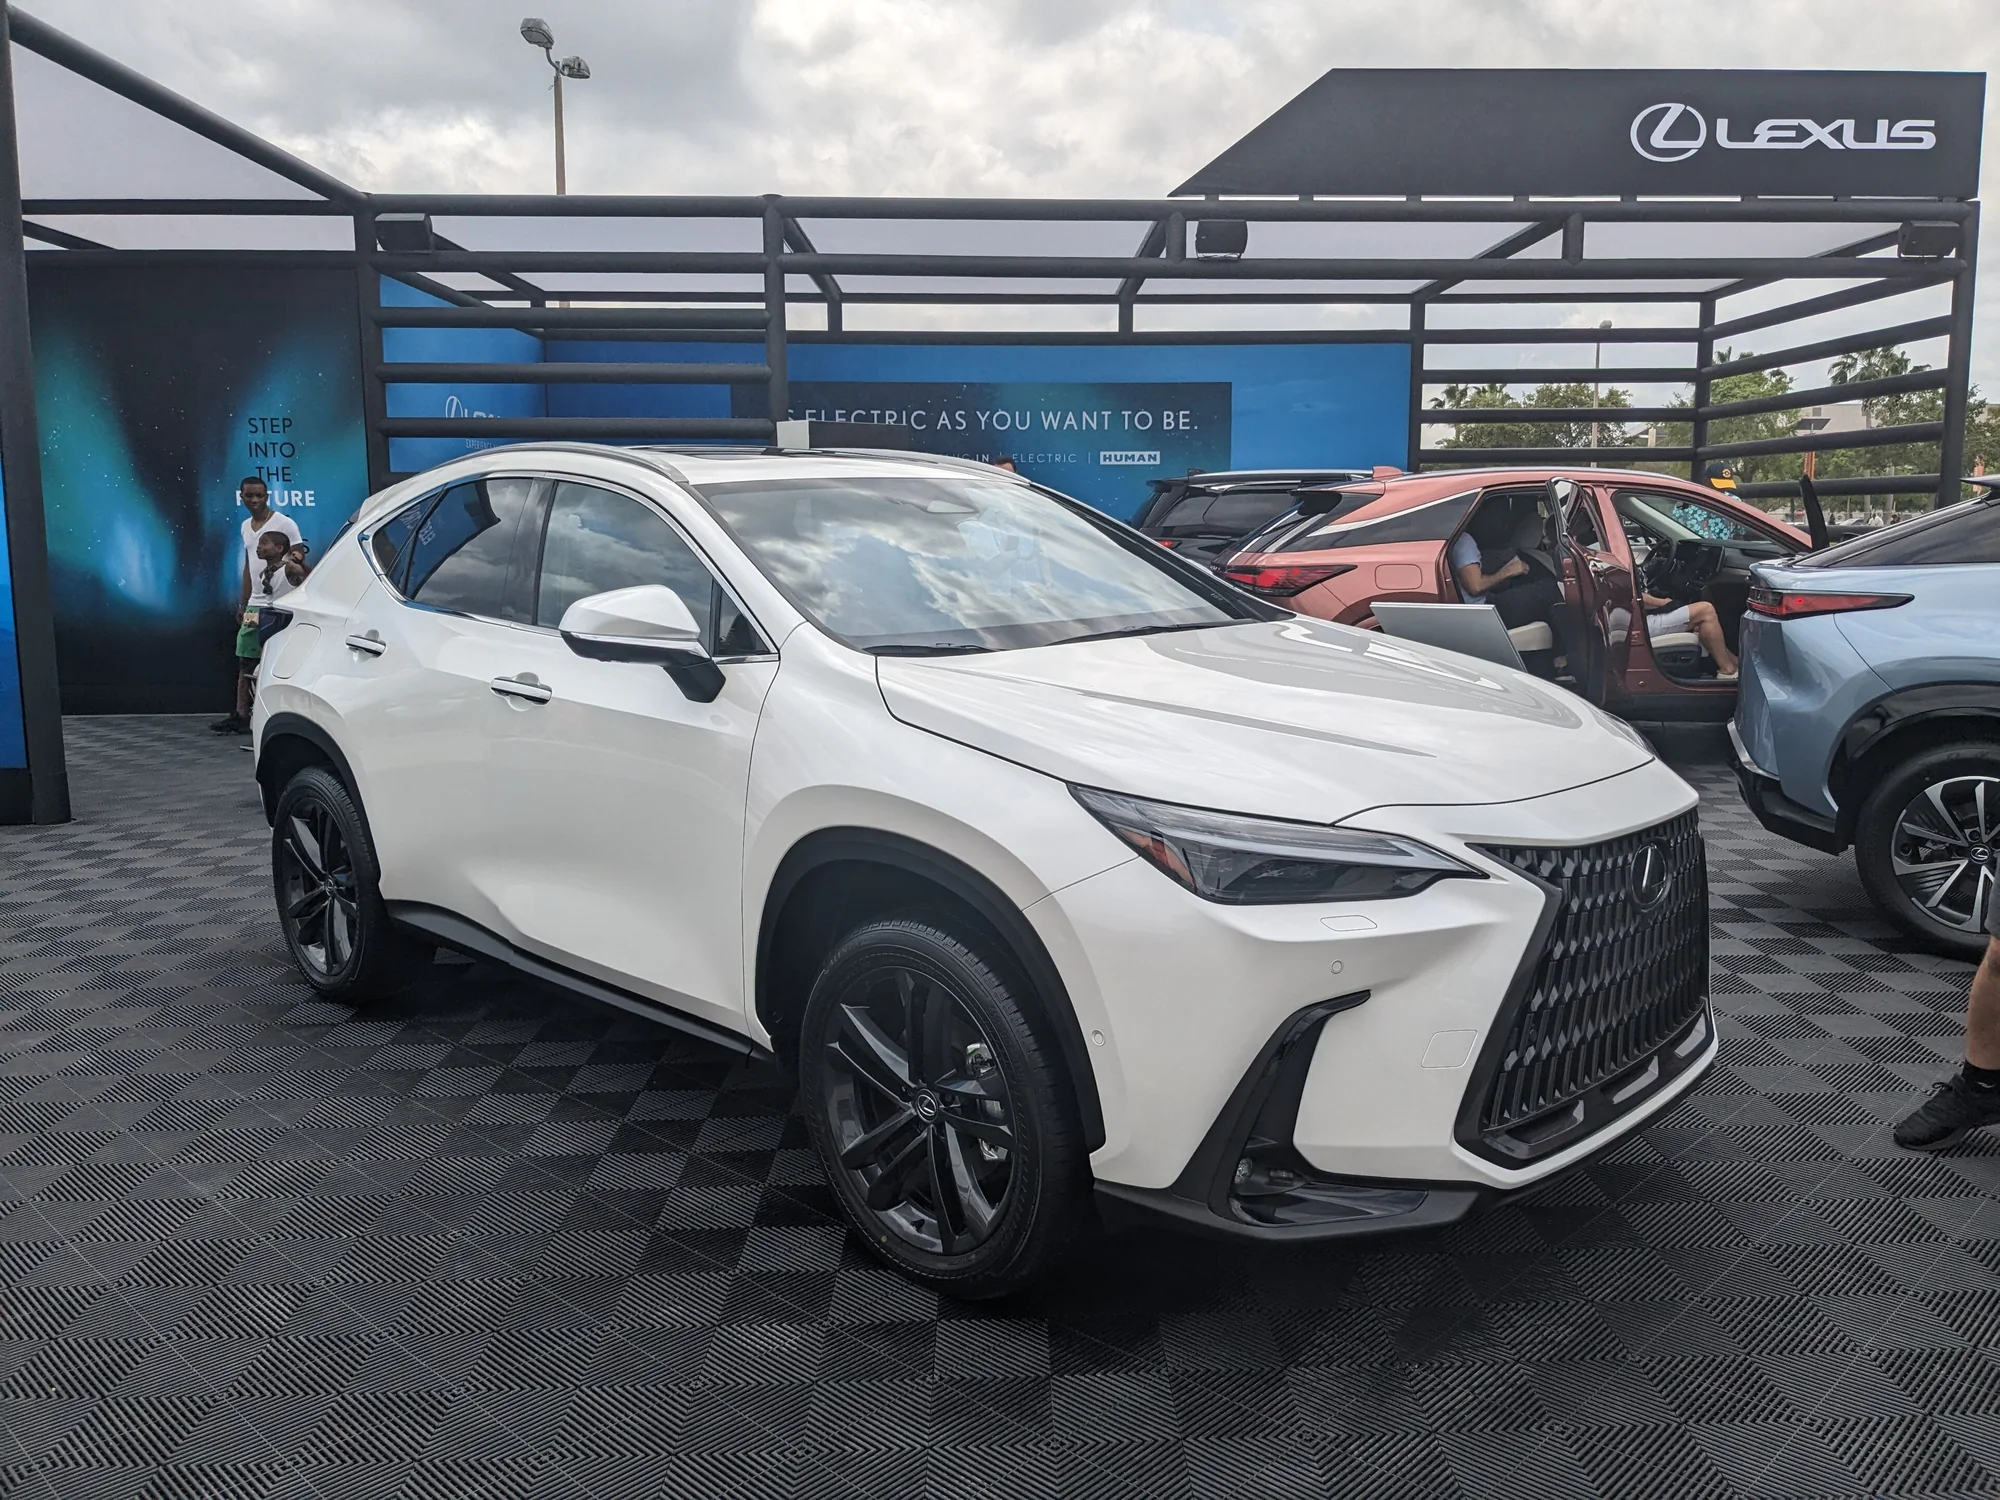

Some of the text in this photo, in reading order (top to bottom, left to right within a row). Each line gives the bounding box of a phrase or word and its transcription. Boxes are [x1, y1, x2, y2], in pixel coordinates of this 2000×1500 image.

[1716, 118, 1937, 150] LEXUS
[248, 417, 293, 434] STEP
[937, 410, 967, 430] AS
[976, 410, 1031, 430] YOU
[1040, 410, 1112, 430] WANT
[1121, 410, 1153, 430] TO
[1162, 410, 1199, 430] BE.
[248, 441, 296, 458] INTO
[1012, 453, 1158, 463] ELECTRIC HUMAN
[255, 466, 292, 483] THE
[235, 490, 316, 507] FTURE
